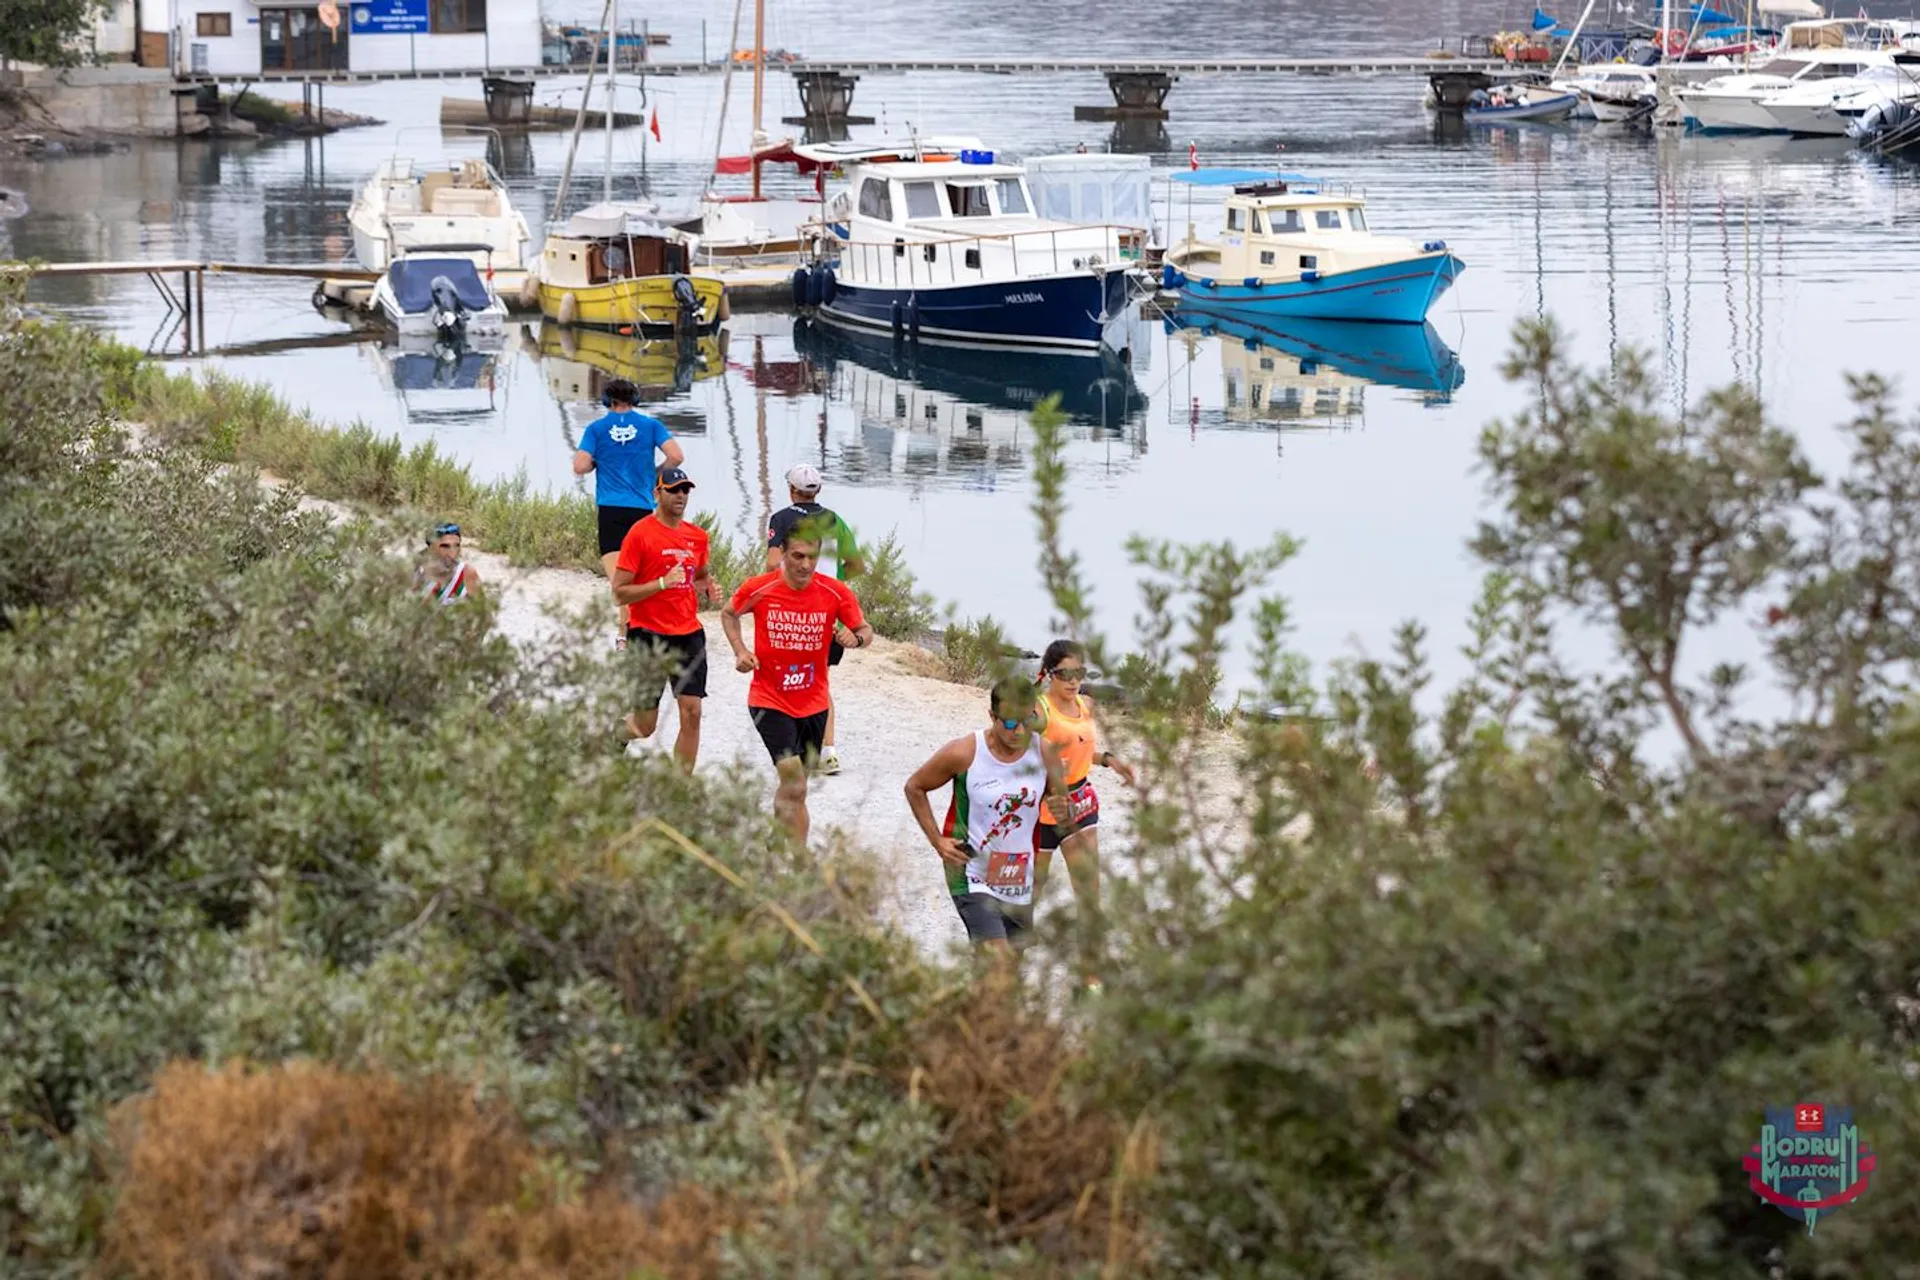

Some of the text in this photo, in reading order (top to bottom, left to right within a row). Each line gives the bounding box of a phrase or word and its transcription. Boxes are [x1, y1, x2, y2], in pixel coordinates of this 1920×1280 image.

[767, 621, 824, 633] BORNOVA
[783, 672, 806, 686] 207
[999, 865, 1020, 878] 149
